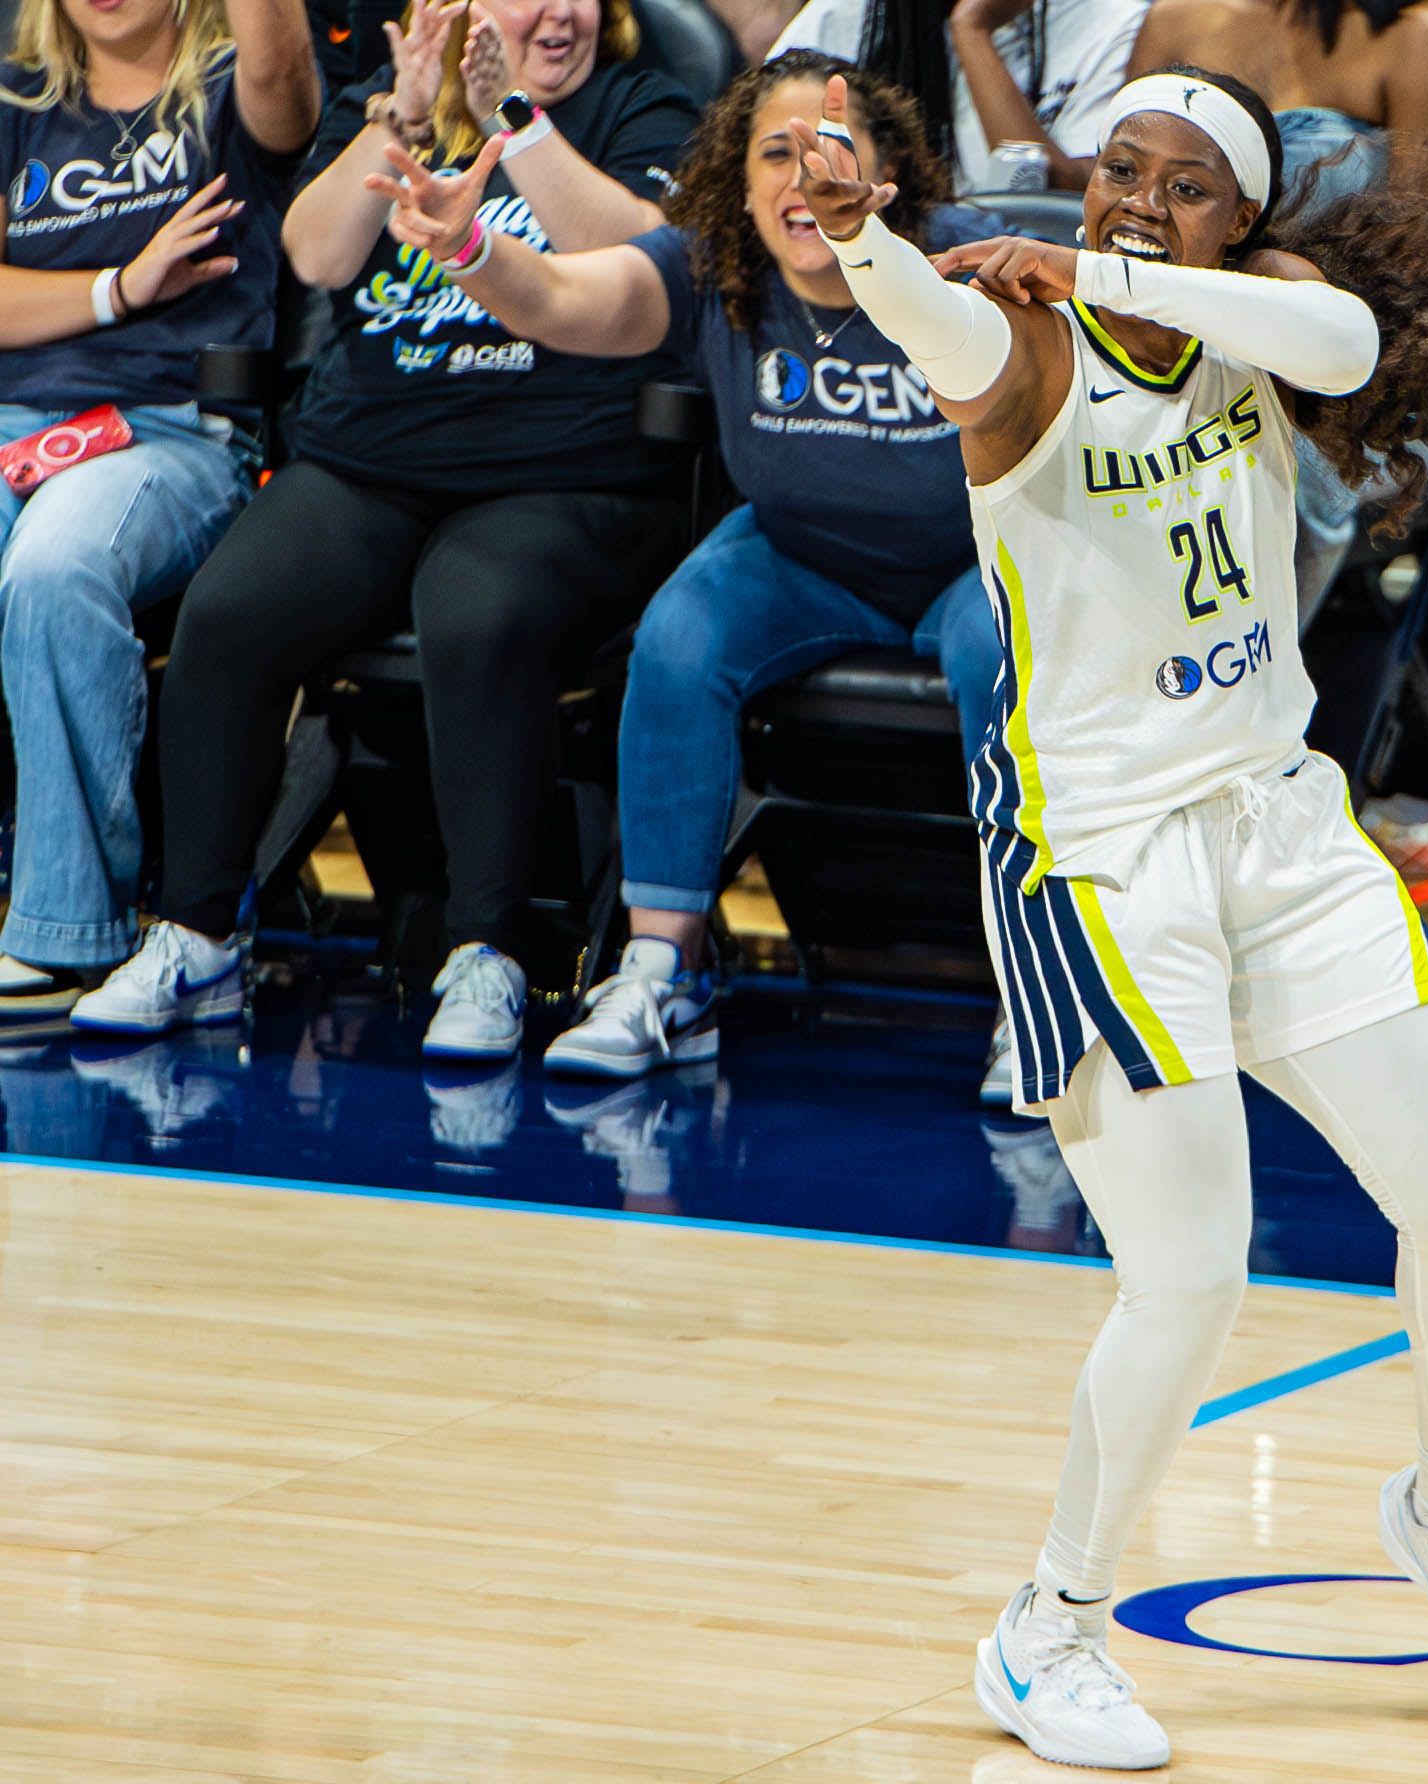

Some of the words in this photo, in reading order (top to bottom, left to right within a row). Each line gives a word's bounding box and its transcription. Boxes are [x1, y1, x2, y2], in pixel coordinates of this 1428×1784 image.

[118, 184, 190, 216] MAVERIKS
[1080, 384, 1263, 498] WINGS
[1166, 504, 1255, 626] 24
